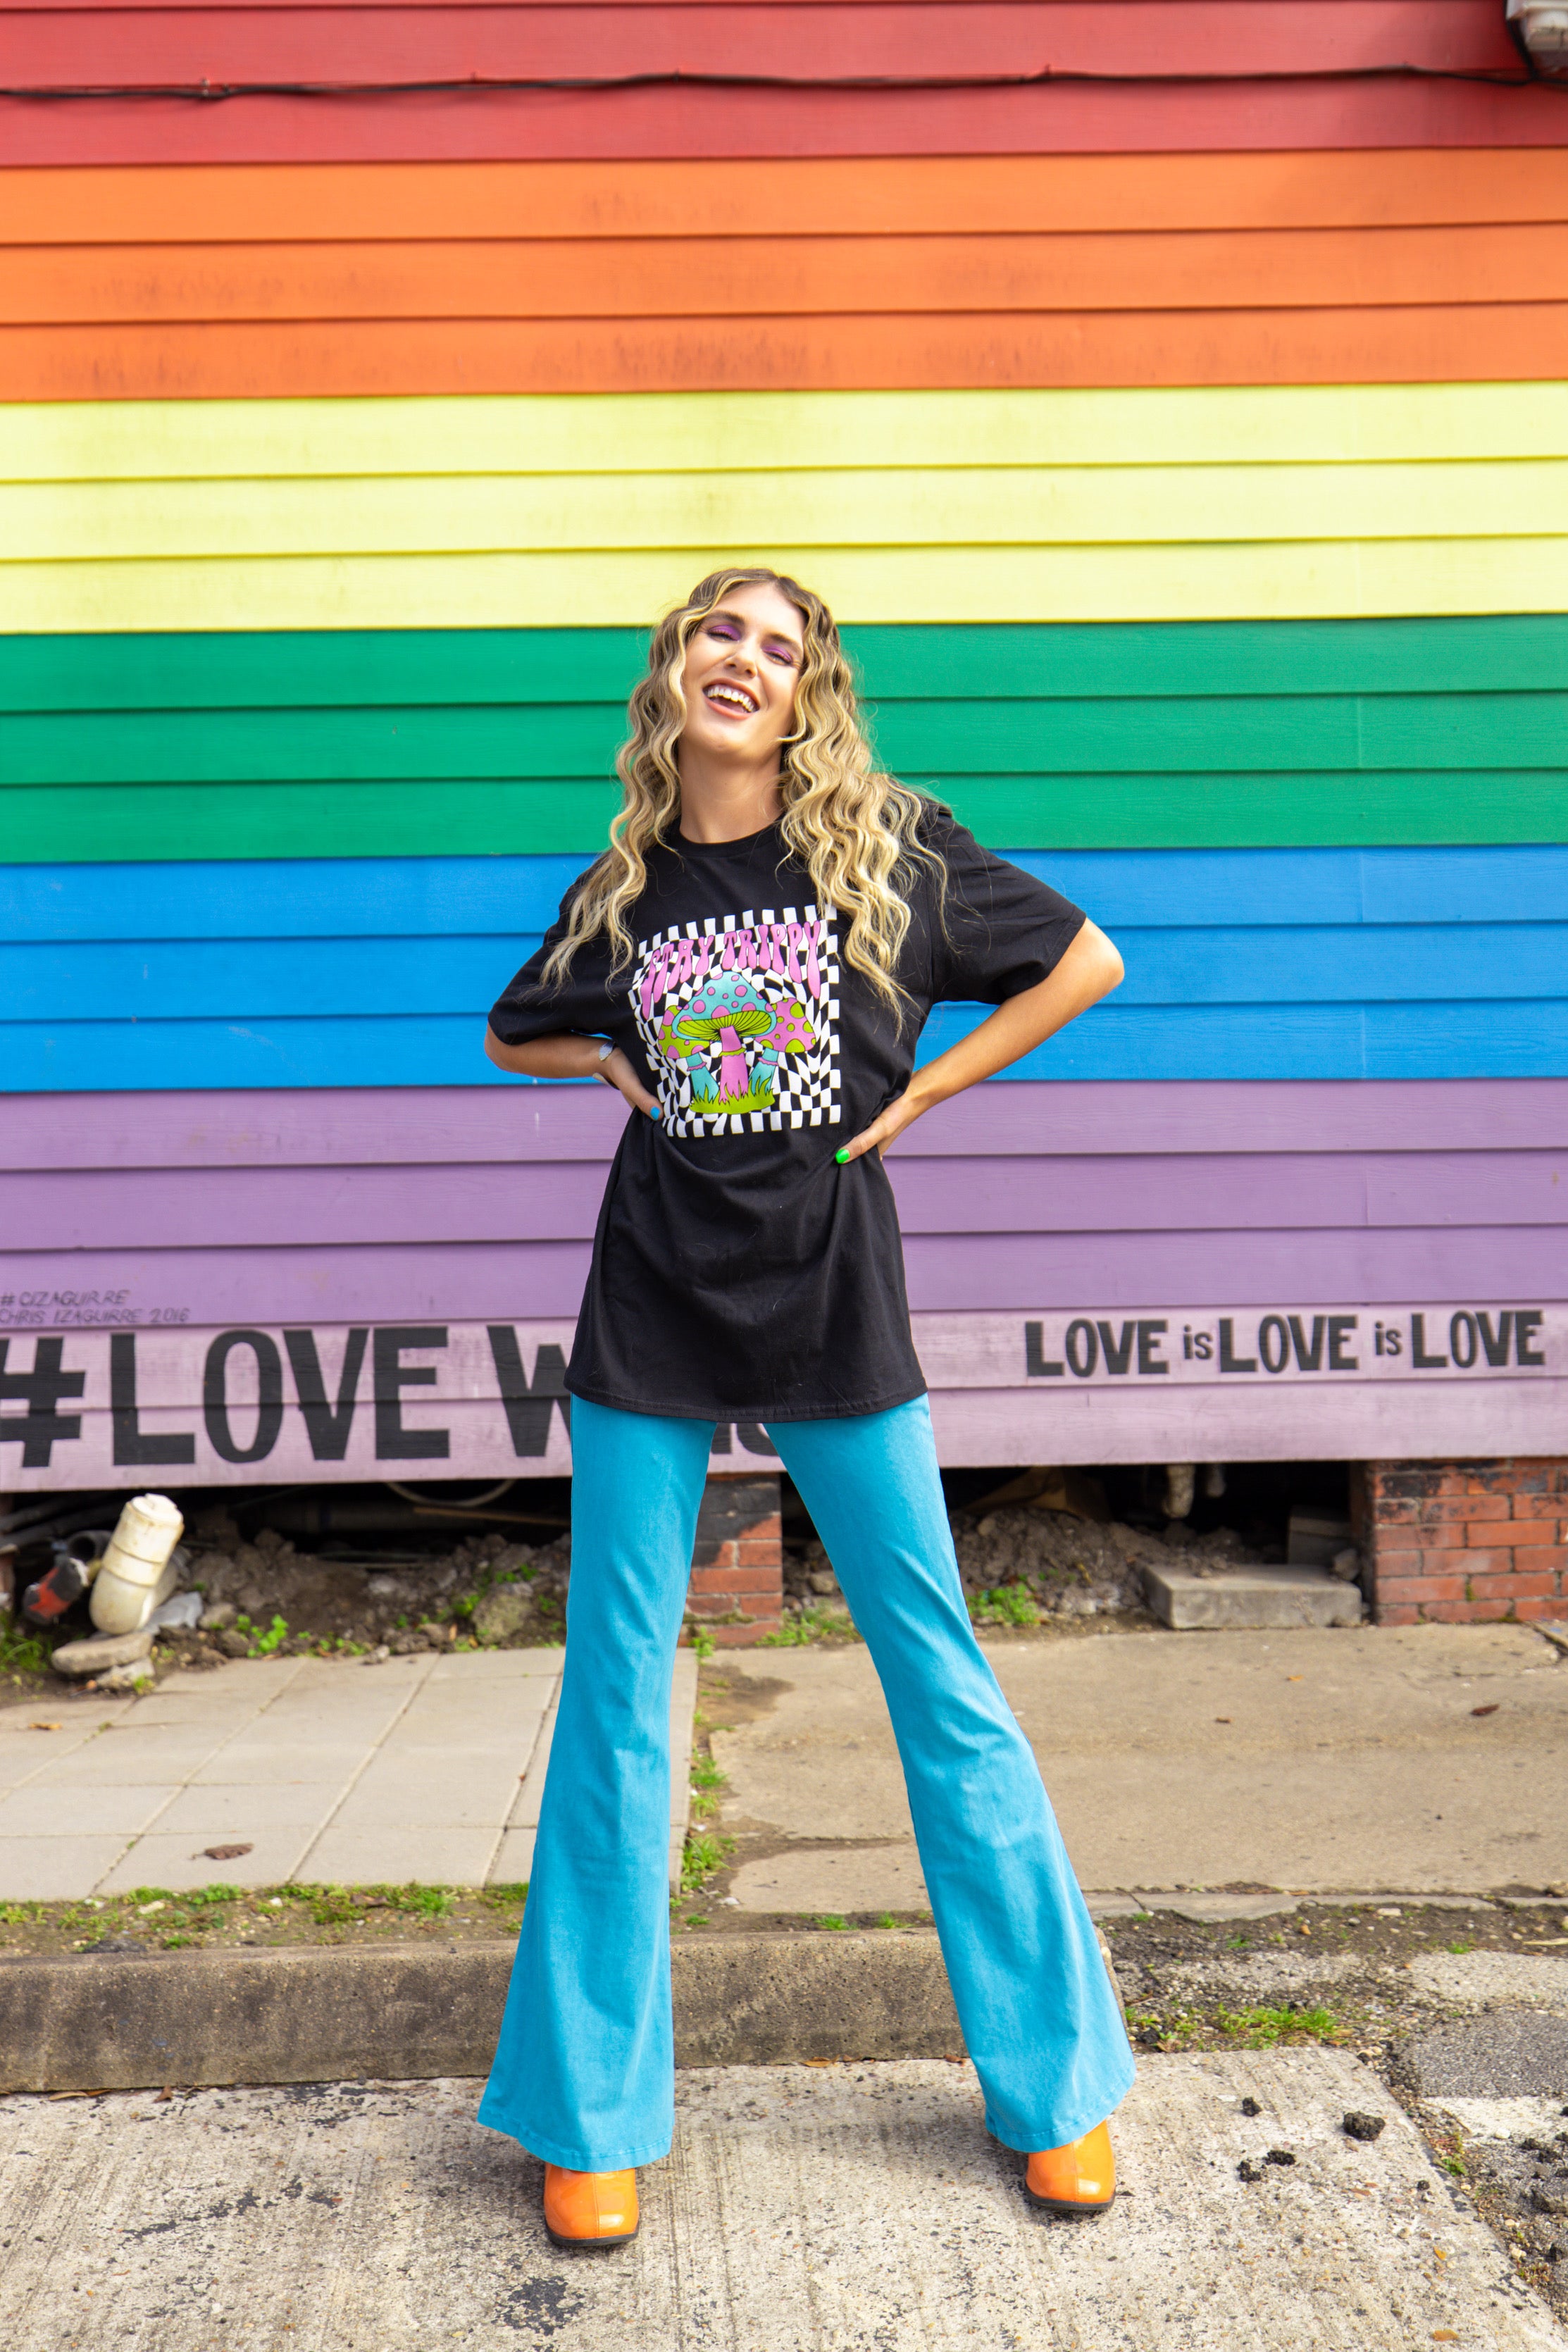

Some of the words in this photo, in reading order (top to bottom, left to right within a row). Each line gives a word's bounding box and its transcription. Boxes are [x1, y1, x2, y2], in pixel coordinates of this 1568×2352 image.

[640, 934, 714, 1021] STAY
[722, 920, 821, 1000] TRIPPY
[0, 1309, 45, 1324] CHRIS
[149, 1307, 190, 1322] 2016
[1025, 1319, 1169, 1378] LOVE
[1183, 1324, 1213, 1359] is
[1219, 1314, 1359, 1374] LOVE
[1374, 1320, 1402, 1356] is
[1411, 1309, 1545, 1368] LOVE
